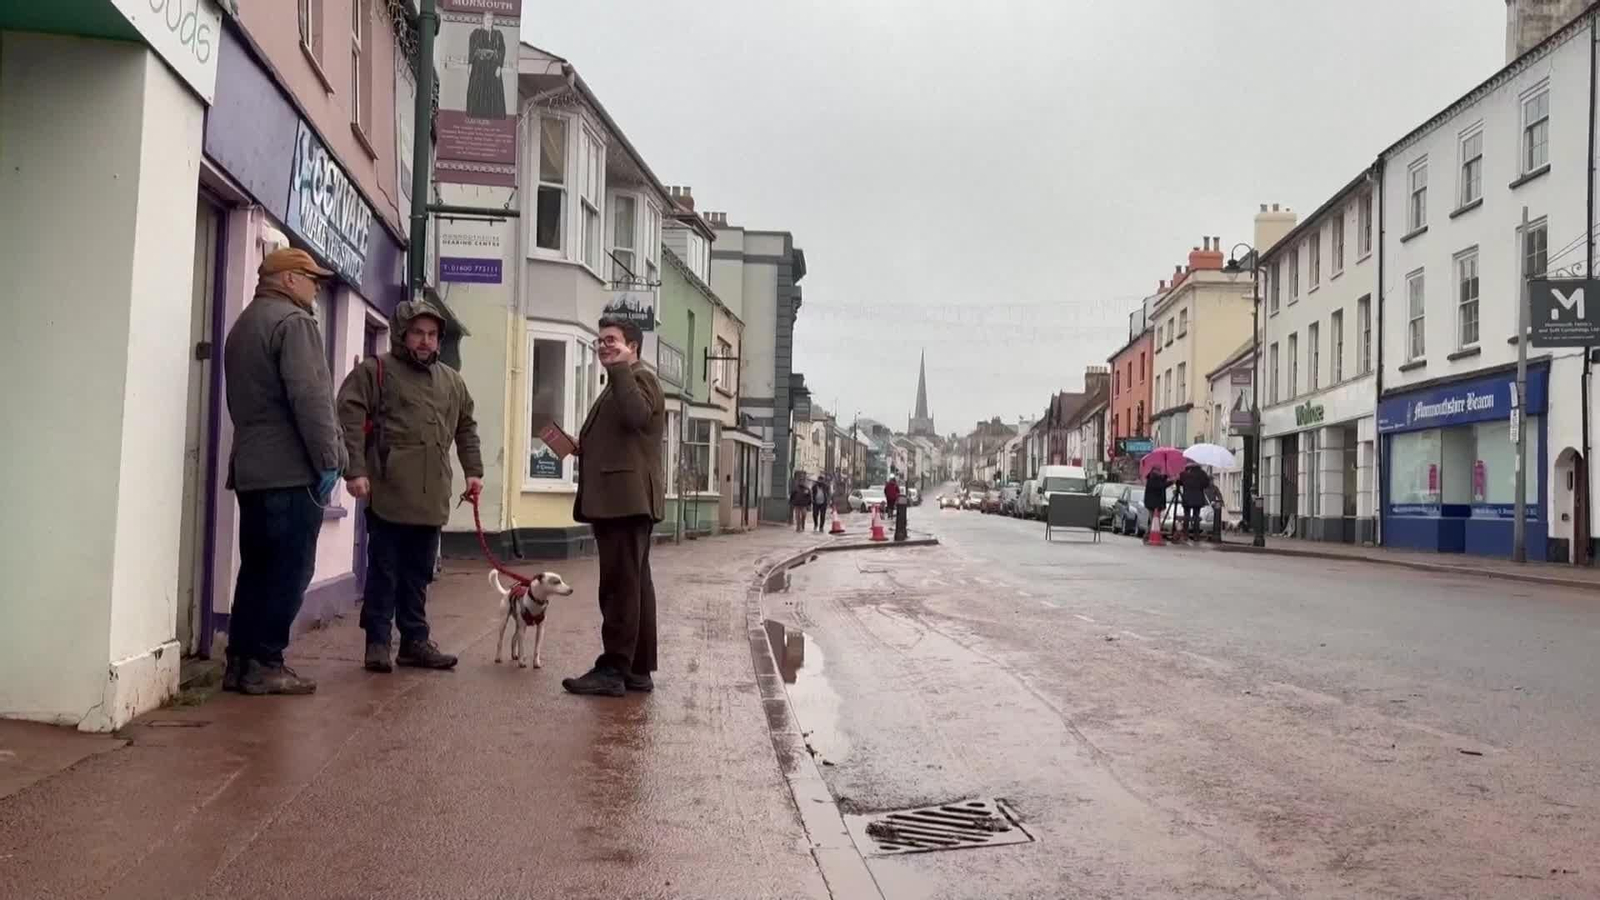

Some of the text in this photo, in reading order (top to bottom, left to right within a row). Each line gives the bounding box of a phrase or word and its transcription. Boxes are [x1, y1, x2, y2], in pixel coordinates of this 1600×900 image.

[452, 0, 513, 10] MONMOUTH
[302, 204, 328, 251] MAKE
[1414, 392, 1494, 421] Monmouthshire Beacon
